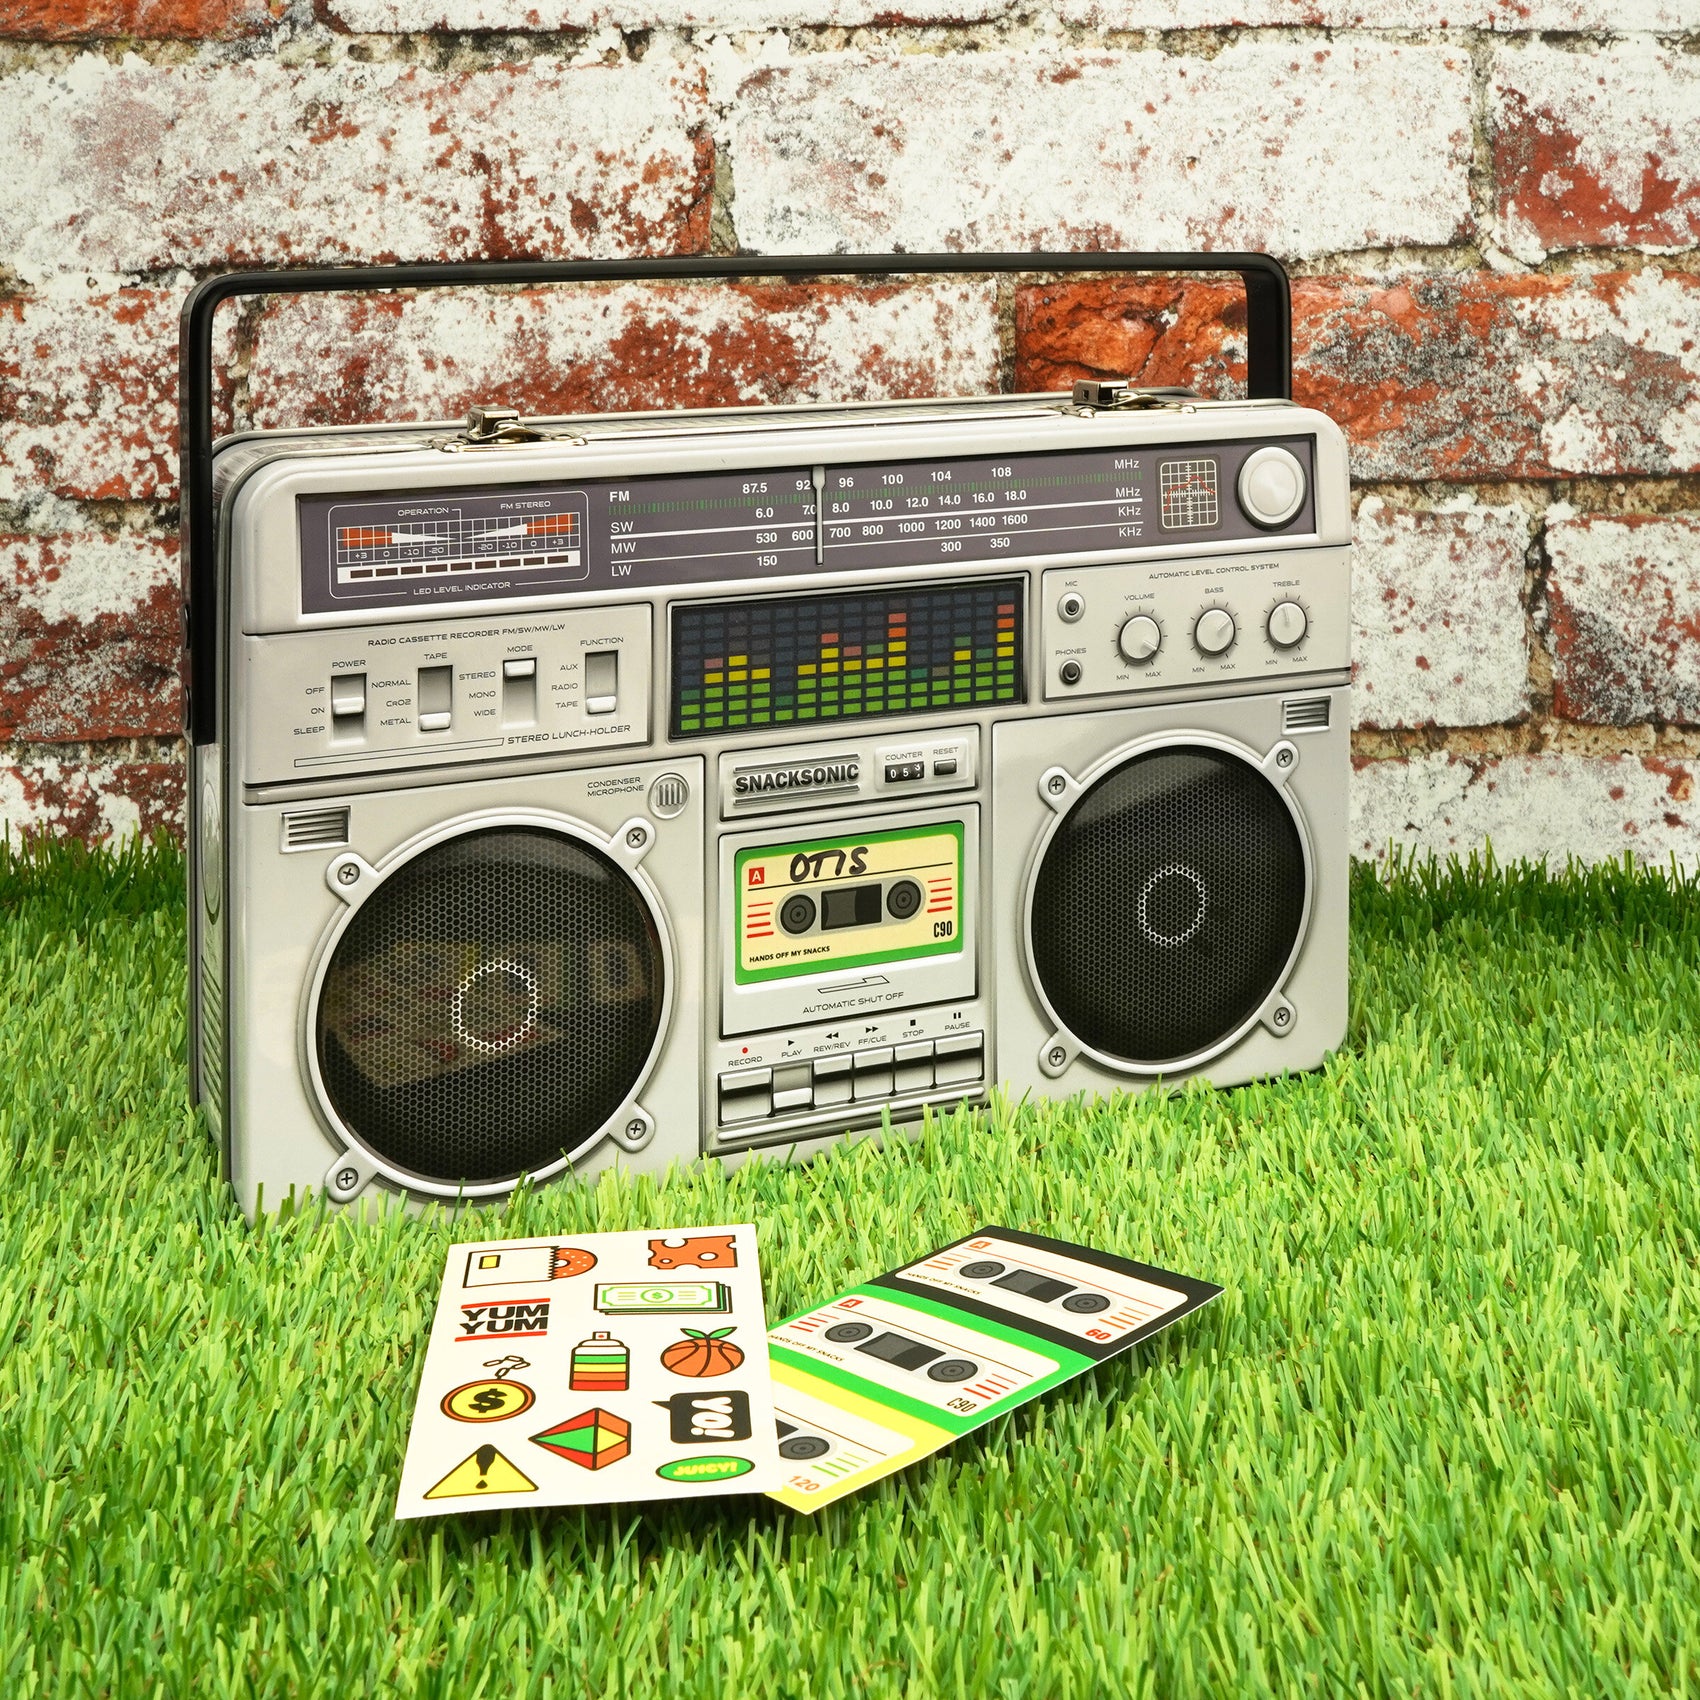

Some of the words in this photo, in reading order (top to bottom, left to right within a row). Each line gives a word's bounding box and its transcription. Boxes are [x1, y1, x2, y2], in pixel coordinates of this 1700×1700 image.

[609, 491, 630, 502] FM
[742, 483, 767, 494] 87.5
[796, 480, 811, 491] 92
[839, 477, 854, 488] 96
[882, 474, 903, 485] 100
[931, 471, 952, 481] 104
[991, 467, 1012, 477] 108
[1115, 459, 1140, 470] MHz
[500, 502, 513, 510] FM
[515, 500, 551, 509] STEREO
[610, 521, 633, 532] SW
[755, 508, 774, 518] 6.0
[832, 503, 850, 513] 8.0
[870, 500, 893, 510] 10.0
[906, 497, 929, 508] 12.0
[938, 495, 961, 505] 14.0
[972, 492, 995, 503] 16.0
[1005, 490, 1026, 500] 18.0
[1115, 487, 1141, 498] MHz
[398, 507, 449, 517] OPERATION
[611, 542, 636, 554] MW
[756, 532, 778, 543] 530
[792, 529, 813, 541] 600
[829, 527, 851, 538] 700
[862, 525, 883, 535] 800
[898, 522, 925, 533] 1000
[935, 519, 961, 530] 1200
[969, 517, 995, 527] 1400
[1002, 514, 1028, 525] 1600
[1118, 506, 1141, 516] KHz
[478, 543, 494, 551] -20
[552, 538, 564, 546] +3
[428, 546, 444, 554] -20
[611, 565, 632, 576] LW
[757, 555, 778, 566] 150
[941, 541, 961, 552] 300
[990, 537, 1010, 548] 350
[1119, 526, 1142, 537] KHz
[1149, 570, 1190, 580] AUTOMATIC
[1216, 566, 1249, 574] CONTROL
[1251, 563, 1279, 571] SYSTEM
[413, 587, 432, 595] LED
[434, 585, 462, 594] LEVEL
[465, 581, 511, 591] INDICATOR
[1124, 592, 1155, 601] VOLUME
[368, 638, 396, 646] RADIO
[399, 634, 448, 643] CASSETTE
[450, 630, 500, 639] RECORDER
[502, 624, 566, 635] FM/SW/MW/LW
[580, 637, 624, 646] FUNCTION
[507, 645, 533, 653] MODE
[424, 652, 448, 660] TAPE
[332, 660, 367, 668] POWER
[1220, 663, 1235, 671] MAX
[459, 671, 496, 680] STEREO
[1145, 670, 1162, 678] MAX
[371, 680, 411, 688] NORMAL
[552, 683, 578, 691] RADIO
[305, 687, 325, 695] OFF
[469, 691, 496, 699] MONO
[310, 707, 325, 715] ON
[474, 709, 496, 717] WIDE
[380, 718, 411, 726] METAL
[293, 726, 325, 735] SLEEP
[508, 733, 549, 744] STEREO
[552, 725, 631, 740] LUNCH-HOLDER
[885, 751, 923, 761] COUNTER
[933, 747, 958, 755] RESET
[587, 777, 640, 788] CONDENSER
[734, 763, 859, 794] SNACKSONIC
[587, 785, 644, 797] MICROPHONE
[789, 846, 868, 883] OTIS
[933, 921, 953, 938] C90
[749, 954, 774, 962] HANDS
[803, 946, 830, 955] SNACKS
[802, 1000, 855, 1014] AUTOMATIC
[858, 995, 884, 1005] SHUT
[886, 992, 904, 1001] OFF
[944, 1022, 970, 1031] PAUSE
[902, 1029, 924, 1038] STOP
[858, 1035, 887, 1045] FF/CUE
[813, 1041, 851, 1052] REW/REV
[781, 1049, 802, 1058] PLAY
[728, 1056, 763, 1067] RECORD
[461, 1304, 549, 1322] YUM
[459, 1317, 549, 1335] YUM
[1085, 1328, 1112, 1340] 60
[947, 1398, 977, 1412] C90
[691, 1396, 735, 1438] YO!
[673, 1461, 738, 1476] JUICY!
[788, 1475, 820, 1492] 120
